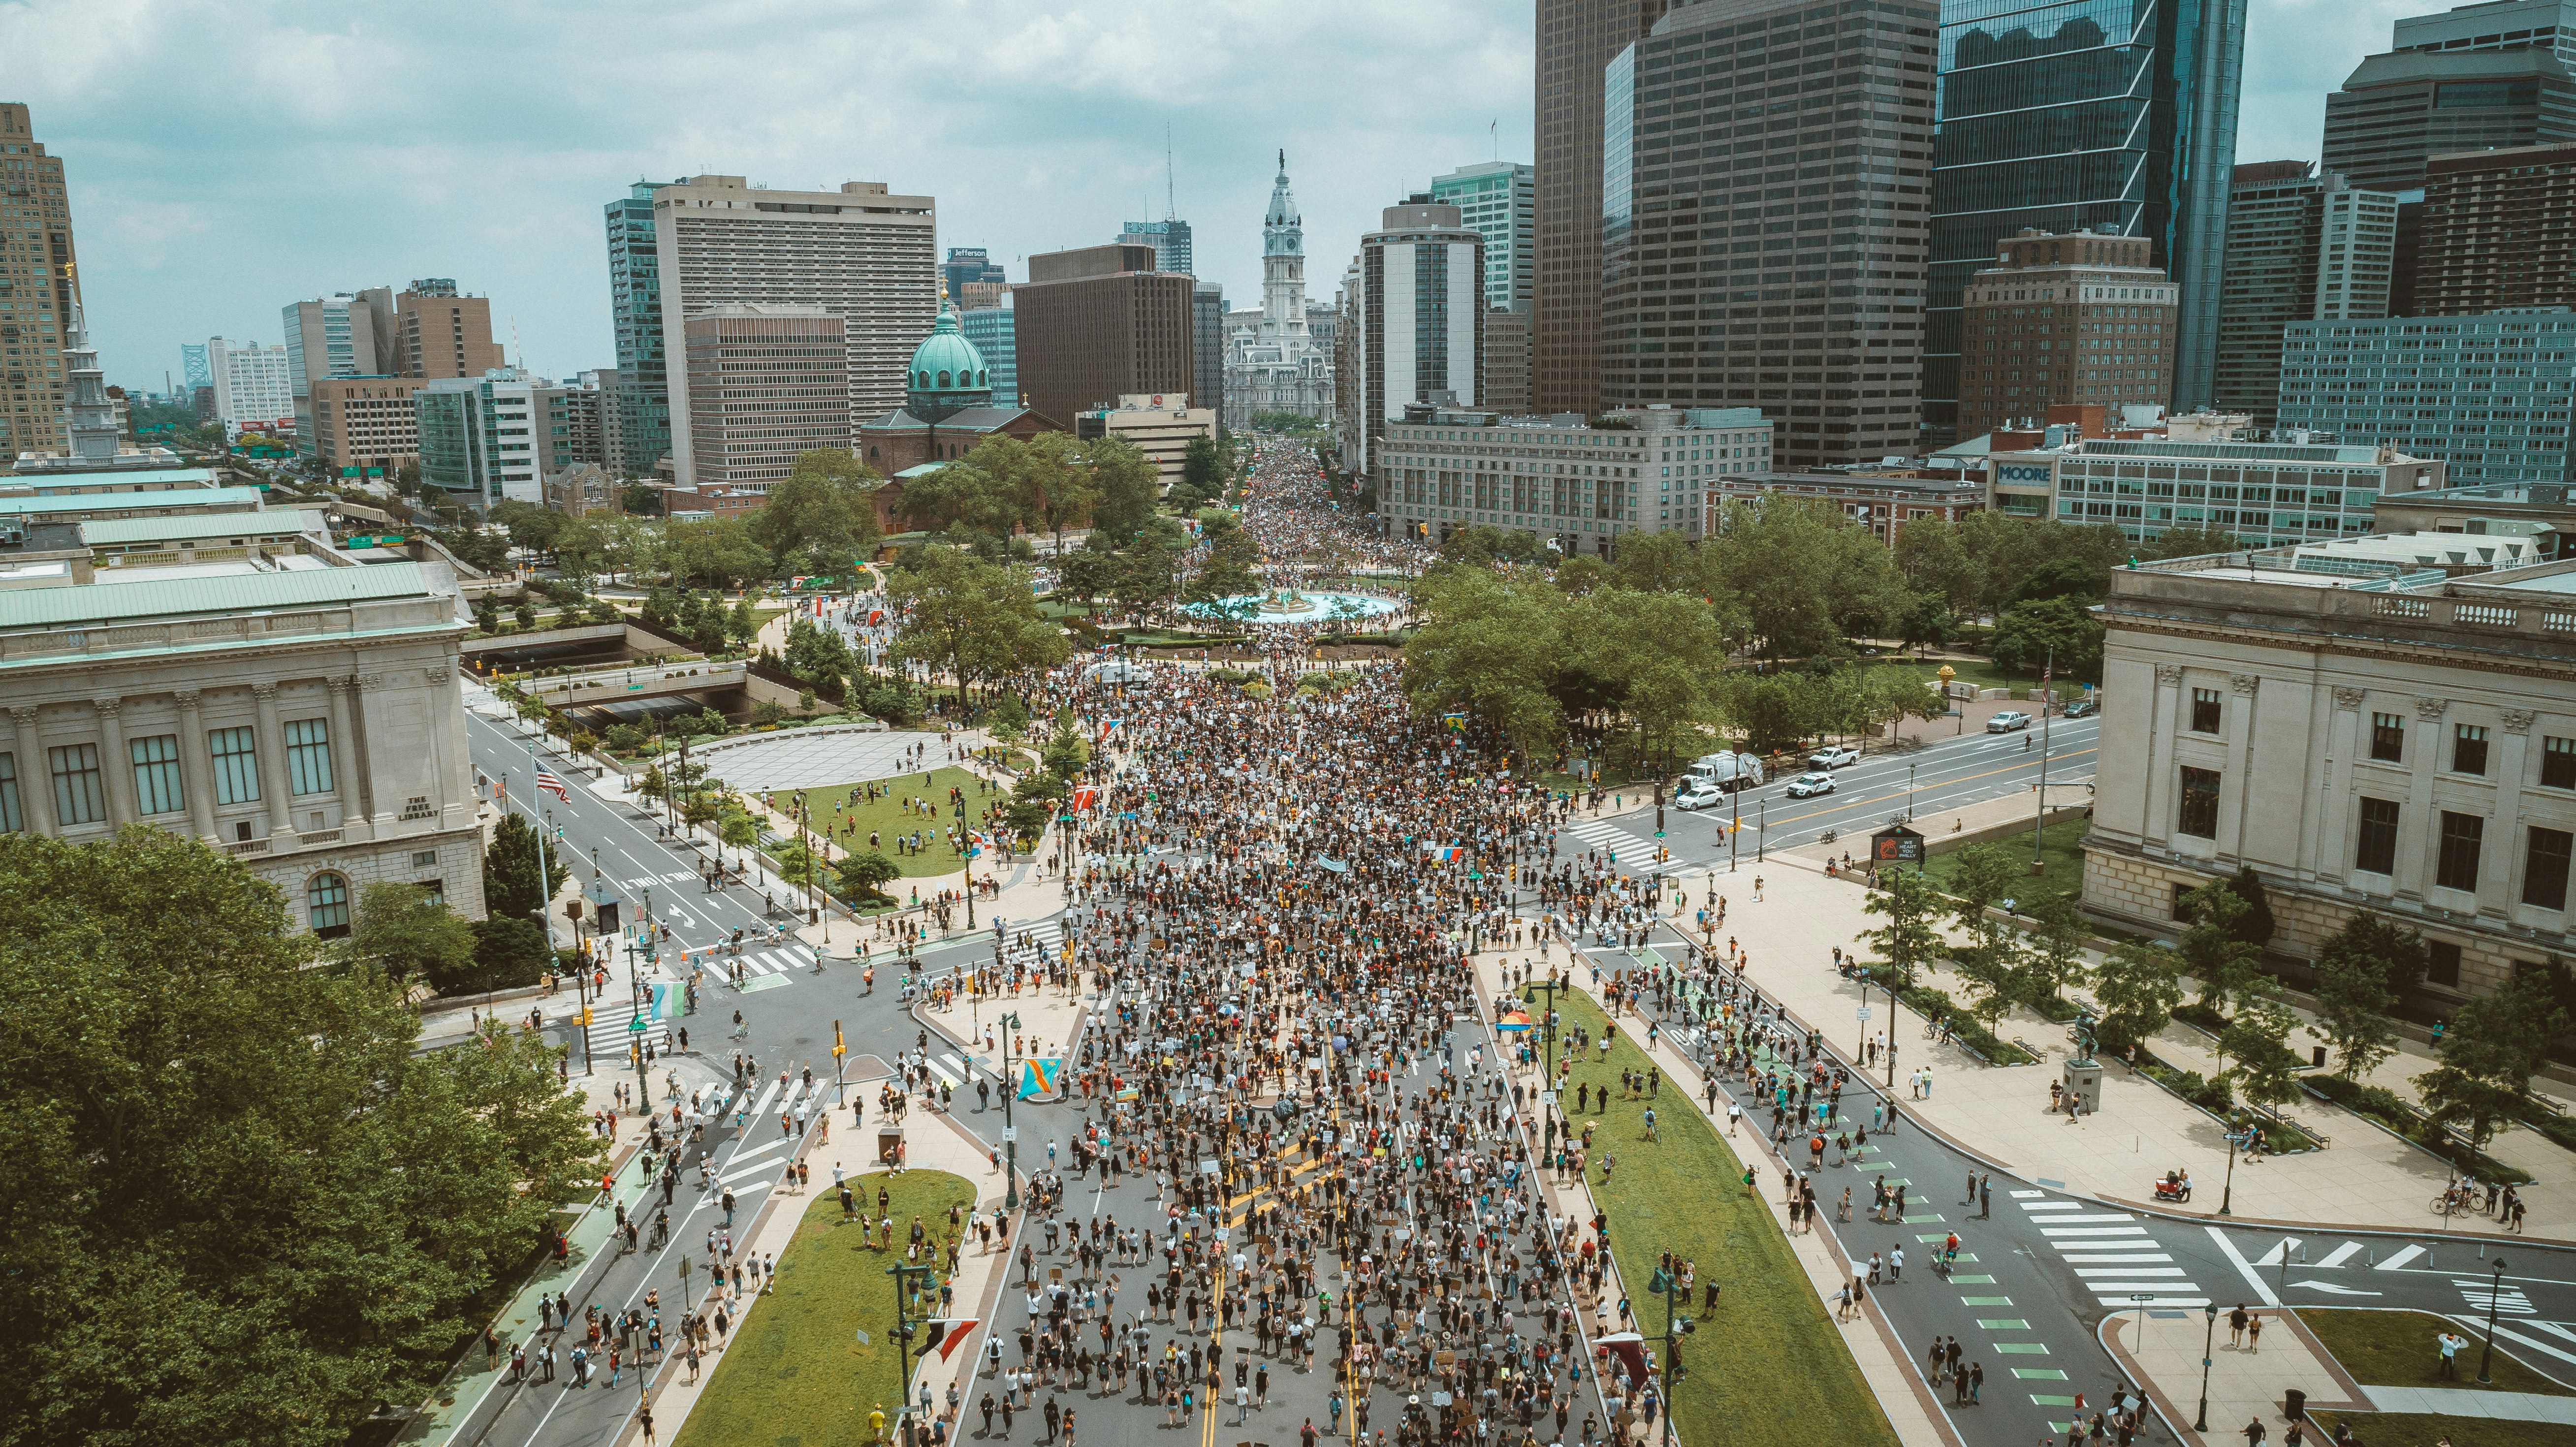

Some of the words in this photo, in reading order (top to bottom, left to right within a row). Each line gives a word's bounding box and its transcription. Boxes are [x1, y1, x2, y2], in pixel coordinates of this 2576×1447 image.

[1127, 221, 1169, 234] PSFS
[1999, 466, 2051, 481] MOORE
[405, 803, 431, 813] FREE
[398, 810, 439, 822] LIBRARY
[620, 877, 659, 890] ONLY
[660, 871, 698, 884] ONLY
[2451, 1279, 2538, 1314] ONLY
